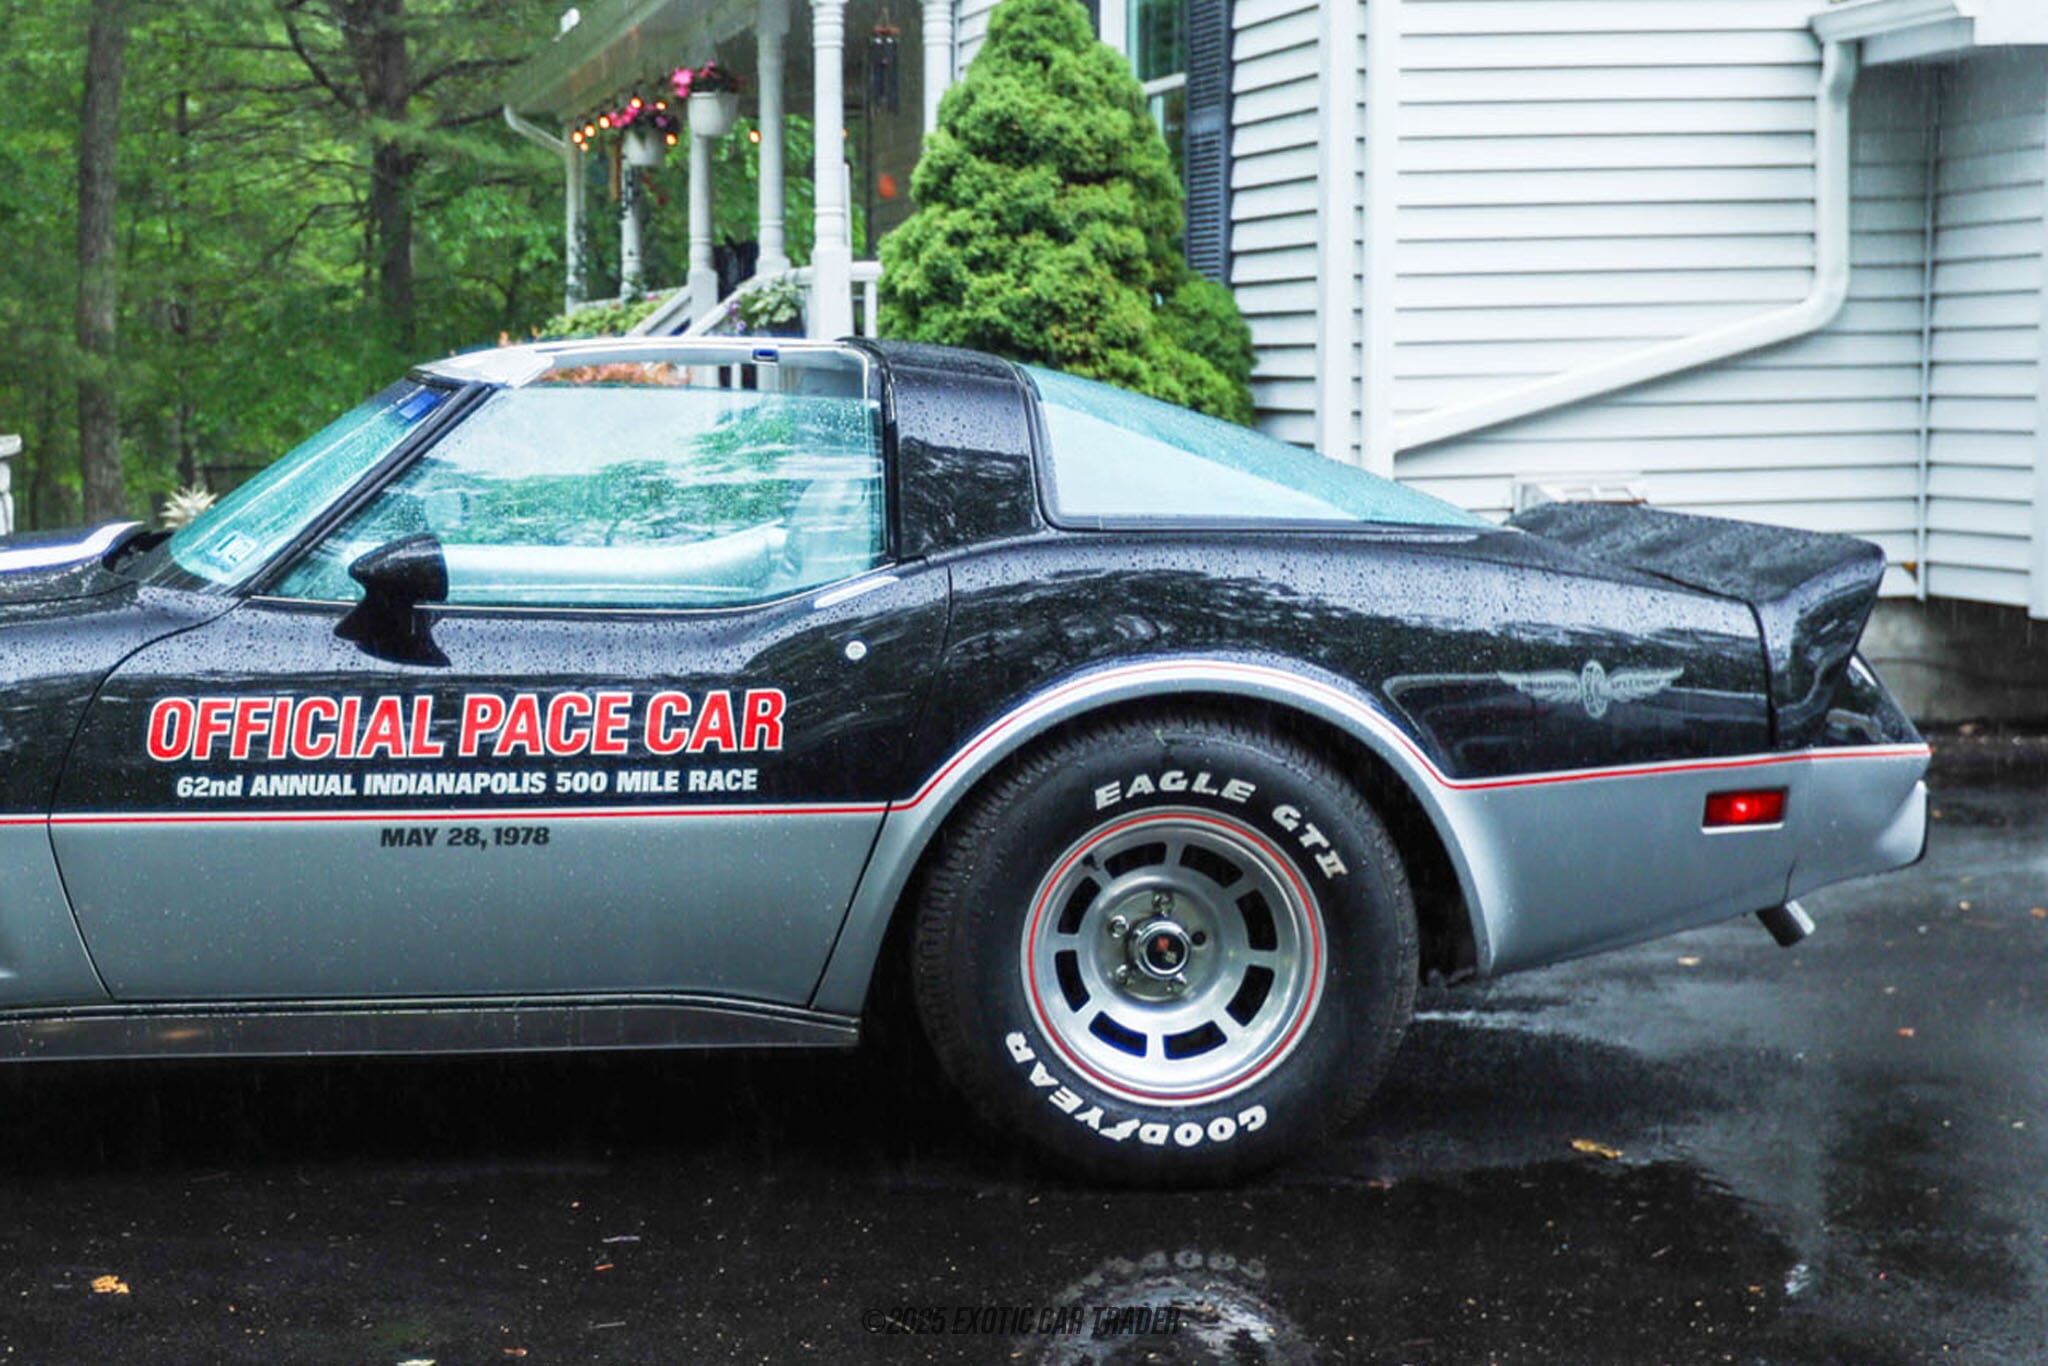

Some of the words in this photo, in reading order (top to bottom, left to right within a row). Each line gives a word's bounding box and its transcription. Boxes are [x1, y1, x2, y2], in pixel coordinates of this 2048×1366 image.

[146, 694, 447, 762] OFFICIAL
[457, 690, 634, 758] PACE
[643, 687, 787, 756] CAR
[176, 774, 244, 798] 62nd
[249, 773, 358, 797] ANNUAL
[363, 771, 548, 796] INDIANAPOLIS
[555, 771, 609, 794] 500
[616, 770, 680, 793] MILE
[689, 768, 759, 792] RACE
[1094, 769, 1257, 810] EAGLE
[380, 828, 438, 848] MAY
[446, 827, 489, 851] 28,
[494, 826, 550, 847] 1978
[1004, 1030, 1268, 1147] GOODYEAR
